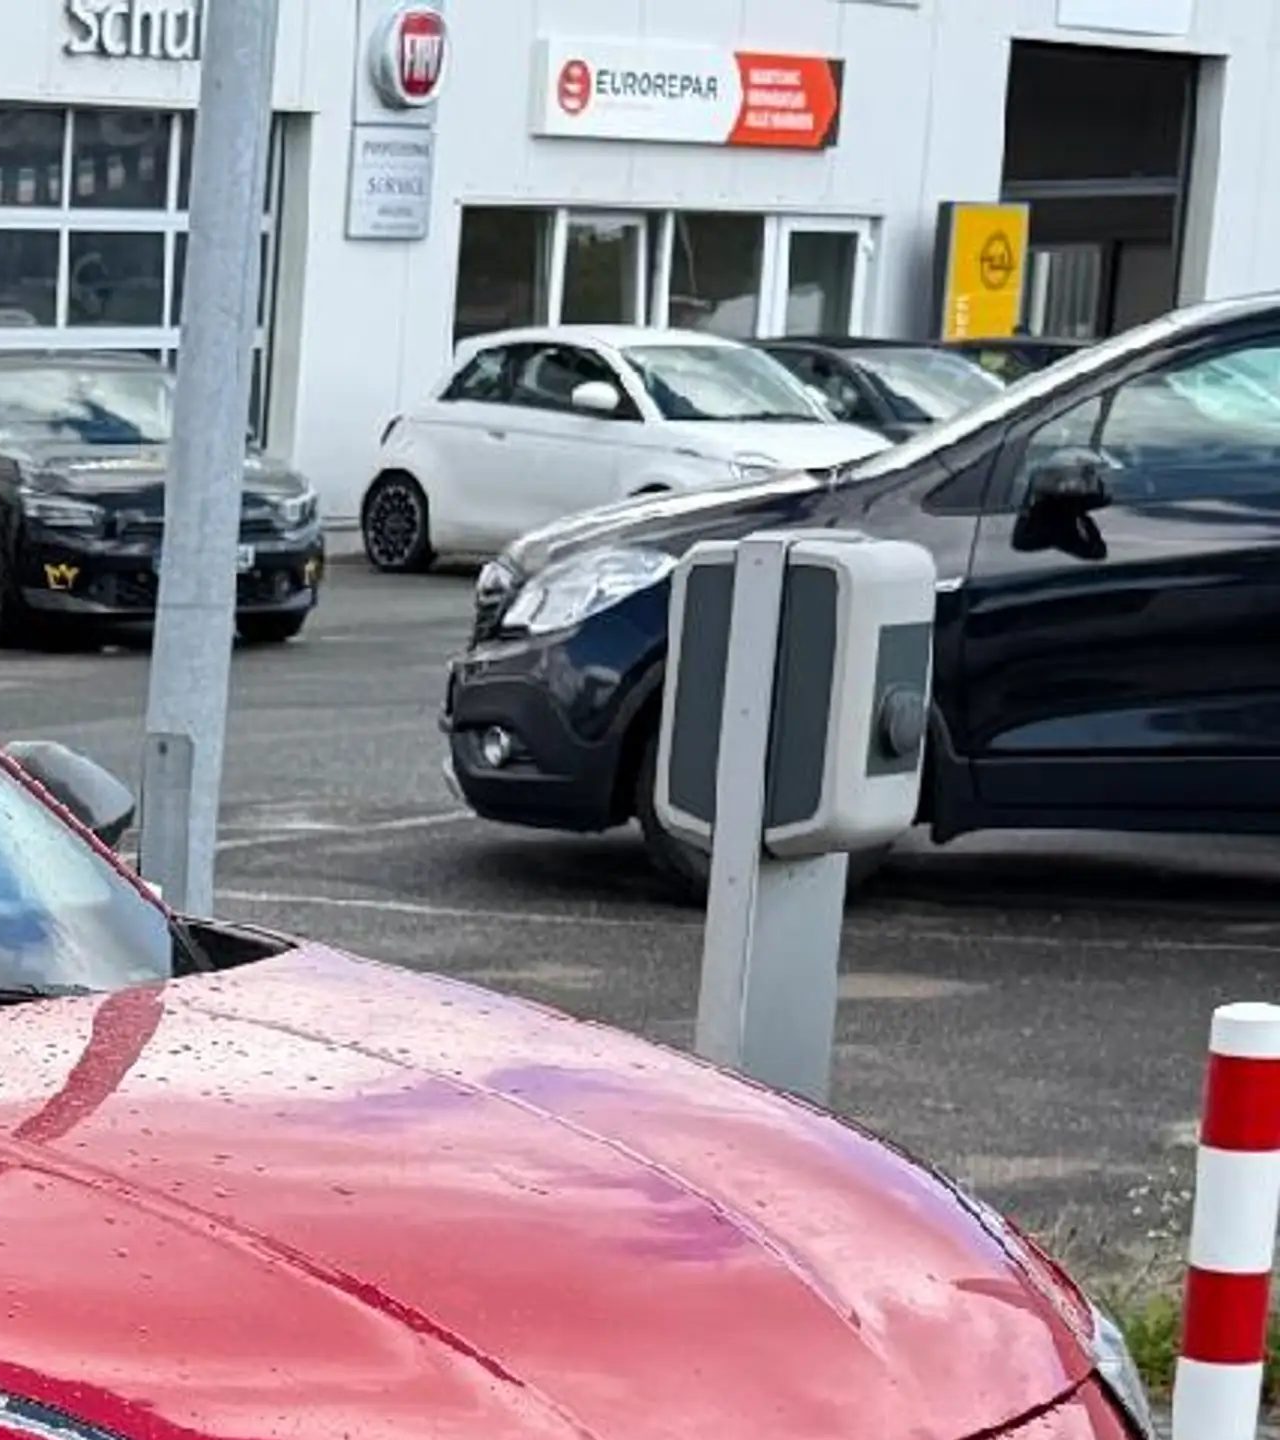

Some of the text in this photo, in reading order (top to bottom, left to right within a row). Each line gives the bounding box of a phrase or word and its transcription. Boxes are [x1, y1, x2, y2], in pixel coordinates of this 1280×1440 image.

[63, 0, 199, 60] Schu
[403, 33, 441, 82] FIAT
[595, 69, 719, 101] EUROREPAR
